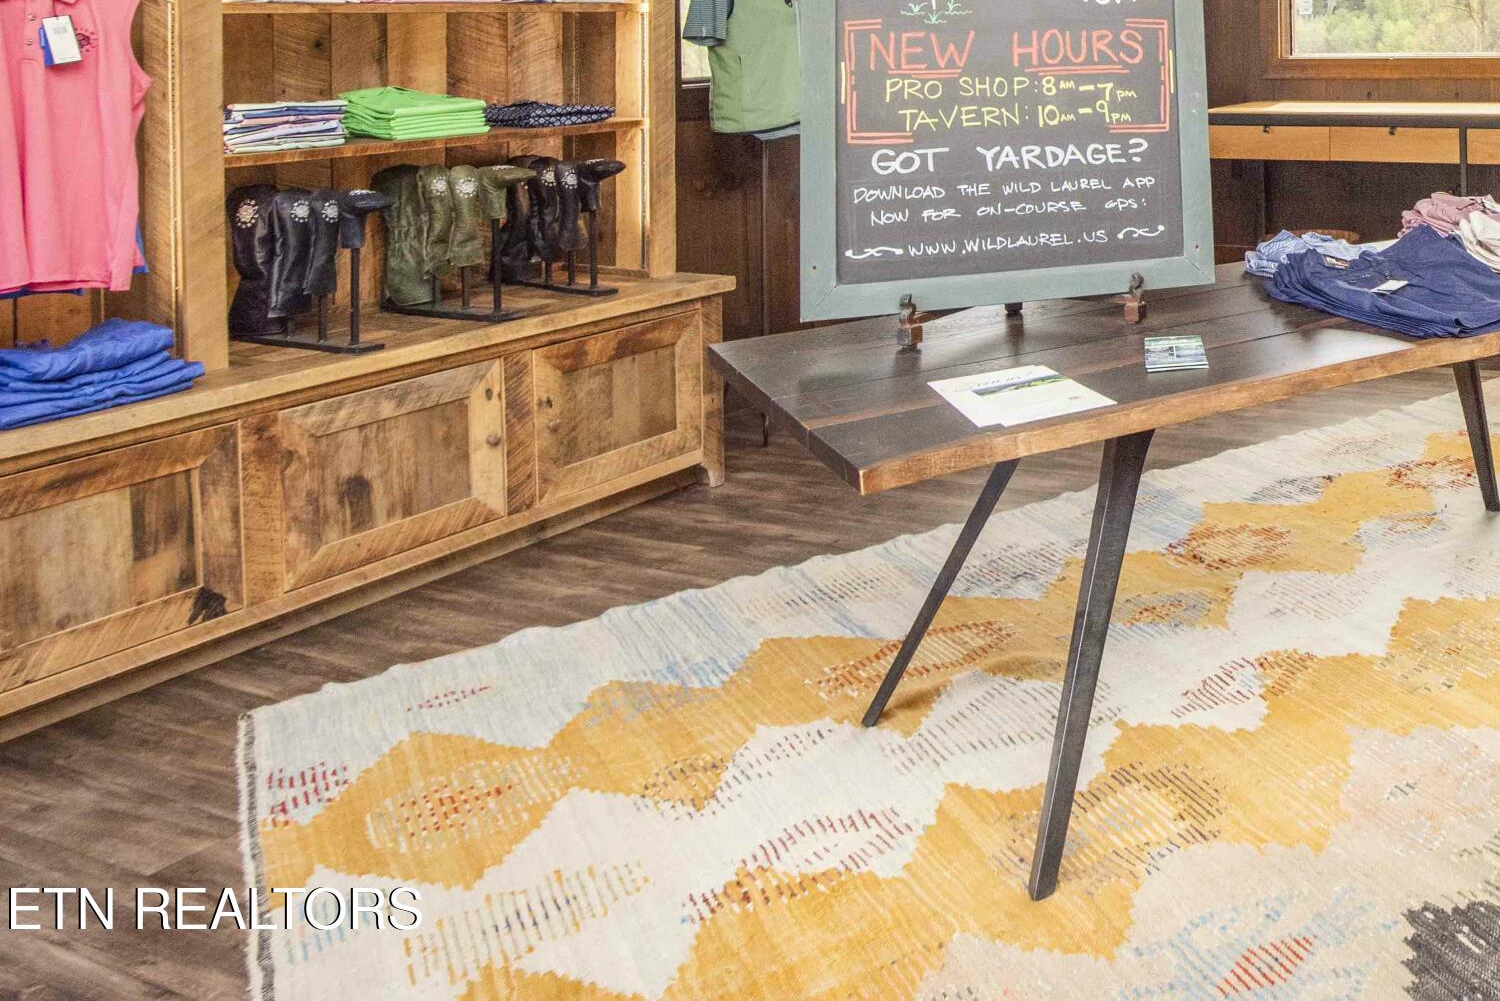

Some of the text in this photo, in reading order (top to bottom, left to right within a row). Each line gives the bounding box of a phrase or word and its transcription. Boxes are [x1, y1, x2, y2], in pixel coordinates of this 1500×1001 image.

[869, 28, 1144, 70] NEW HOURS
[885, 78, 942, 102] PRO
[898, 103, 1030, 131] TAVERN:
[871, 137, 1149, 175] GOT YARDAGE?
[853, 176, 1156, 204] DOWNLOAD THE WILD LAUREL APP
[870, 210, 909, 226] NOW
[921, 207, 962, 222] FOR
[976, 201, 1088, 216] ON-COURSE
